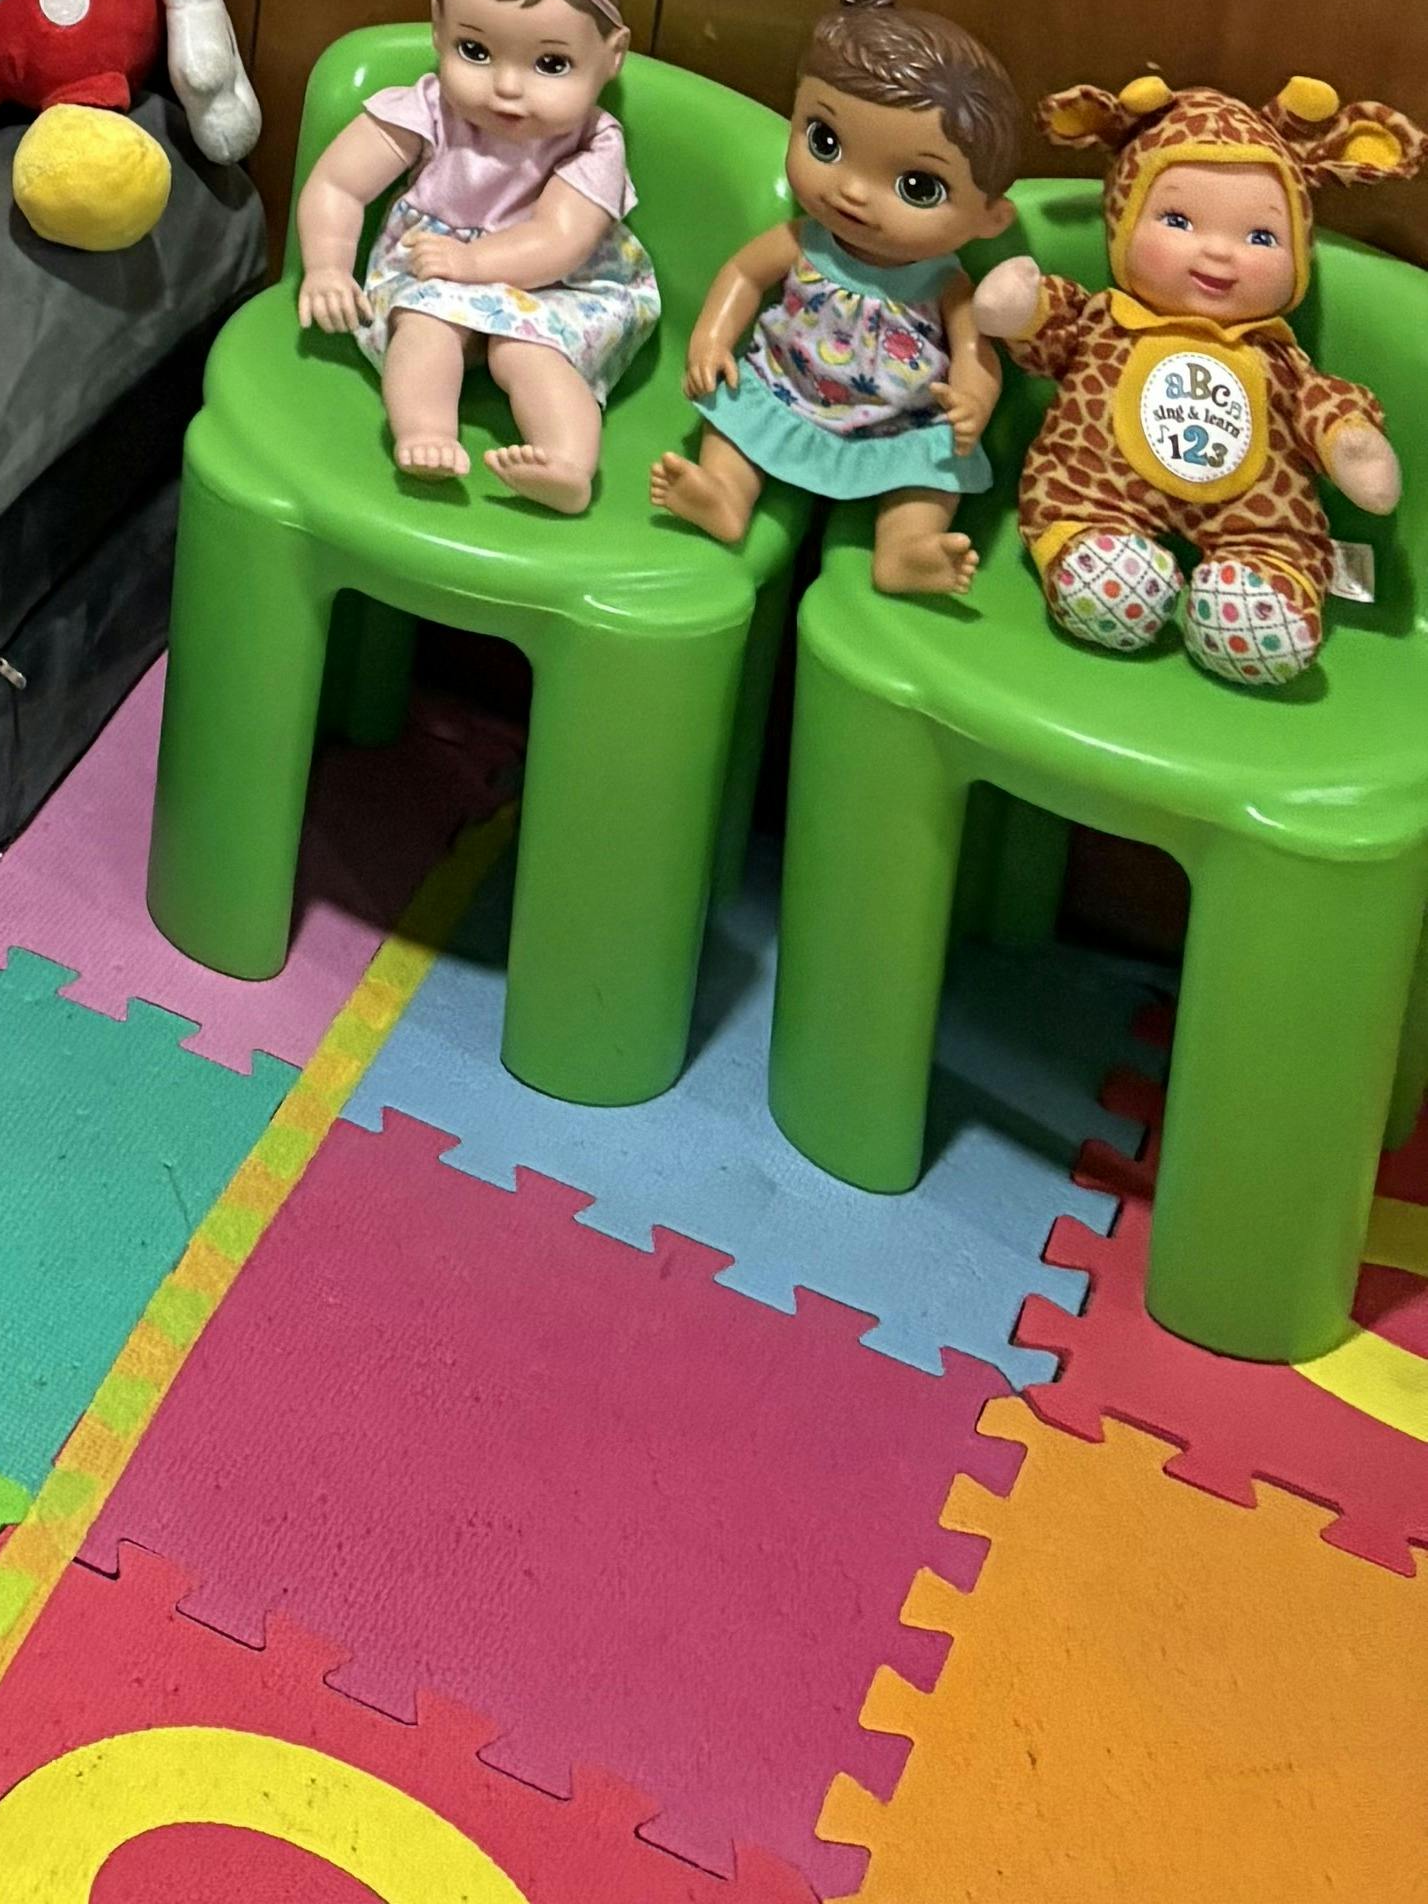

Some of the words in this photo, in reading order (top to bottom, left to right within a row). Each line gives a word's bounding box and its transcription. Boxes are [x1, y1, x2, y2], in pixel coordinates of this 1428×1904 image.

[1153, 404, 1185, 423] sing
[1187, 405, 1199, 420] &
[1204, 407, 1240, 439] learn
[1168, 425, 1228, 468] 123
